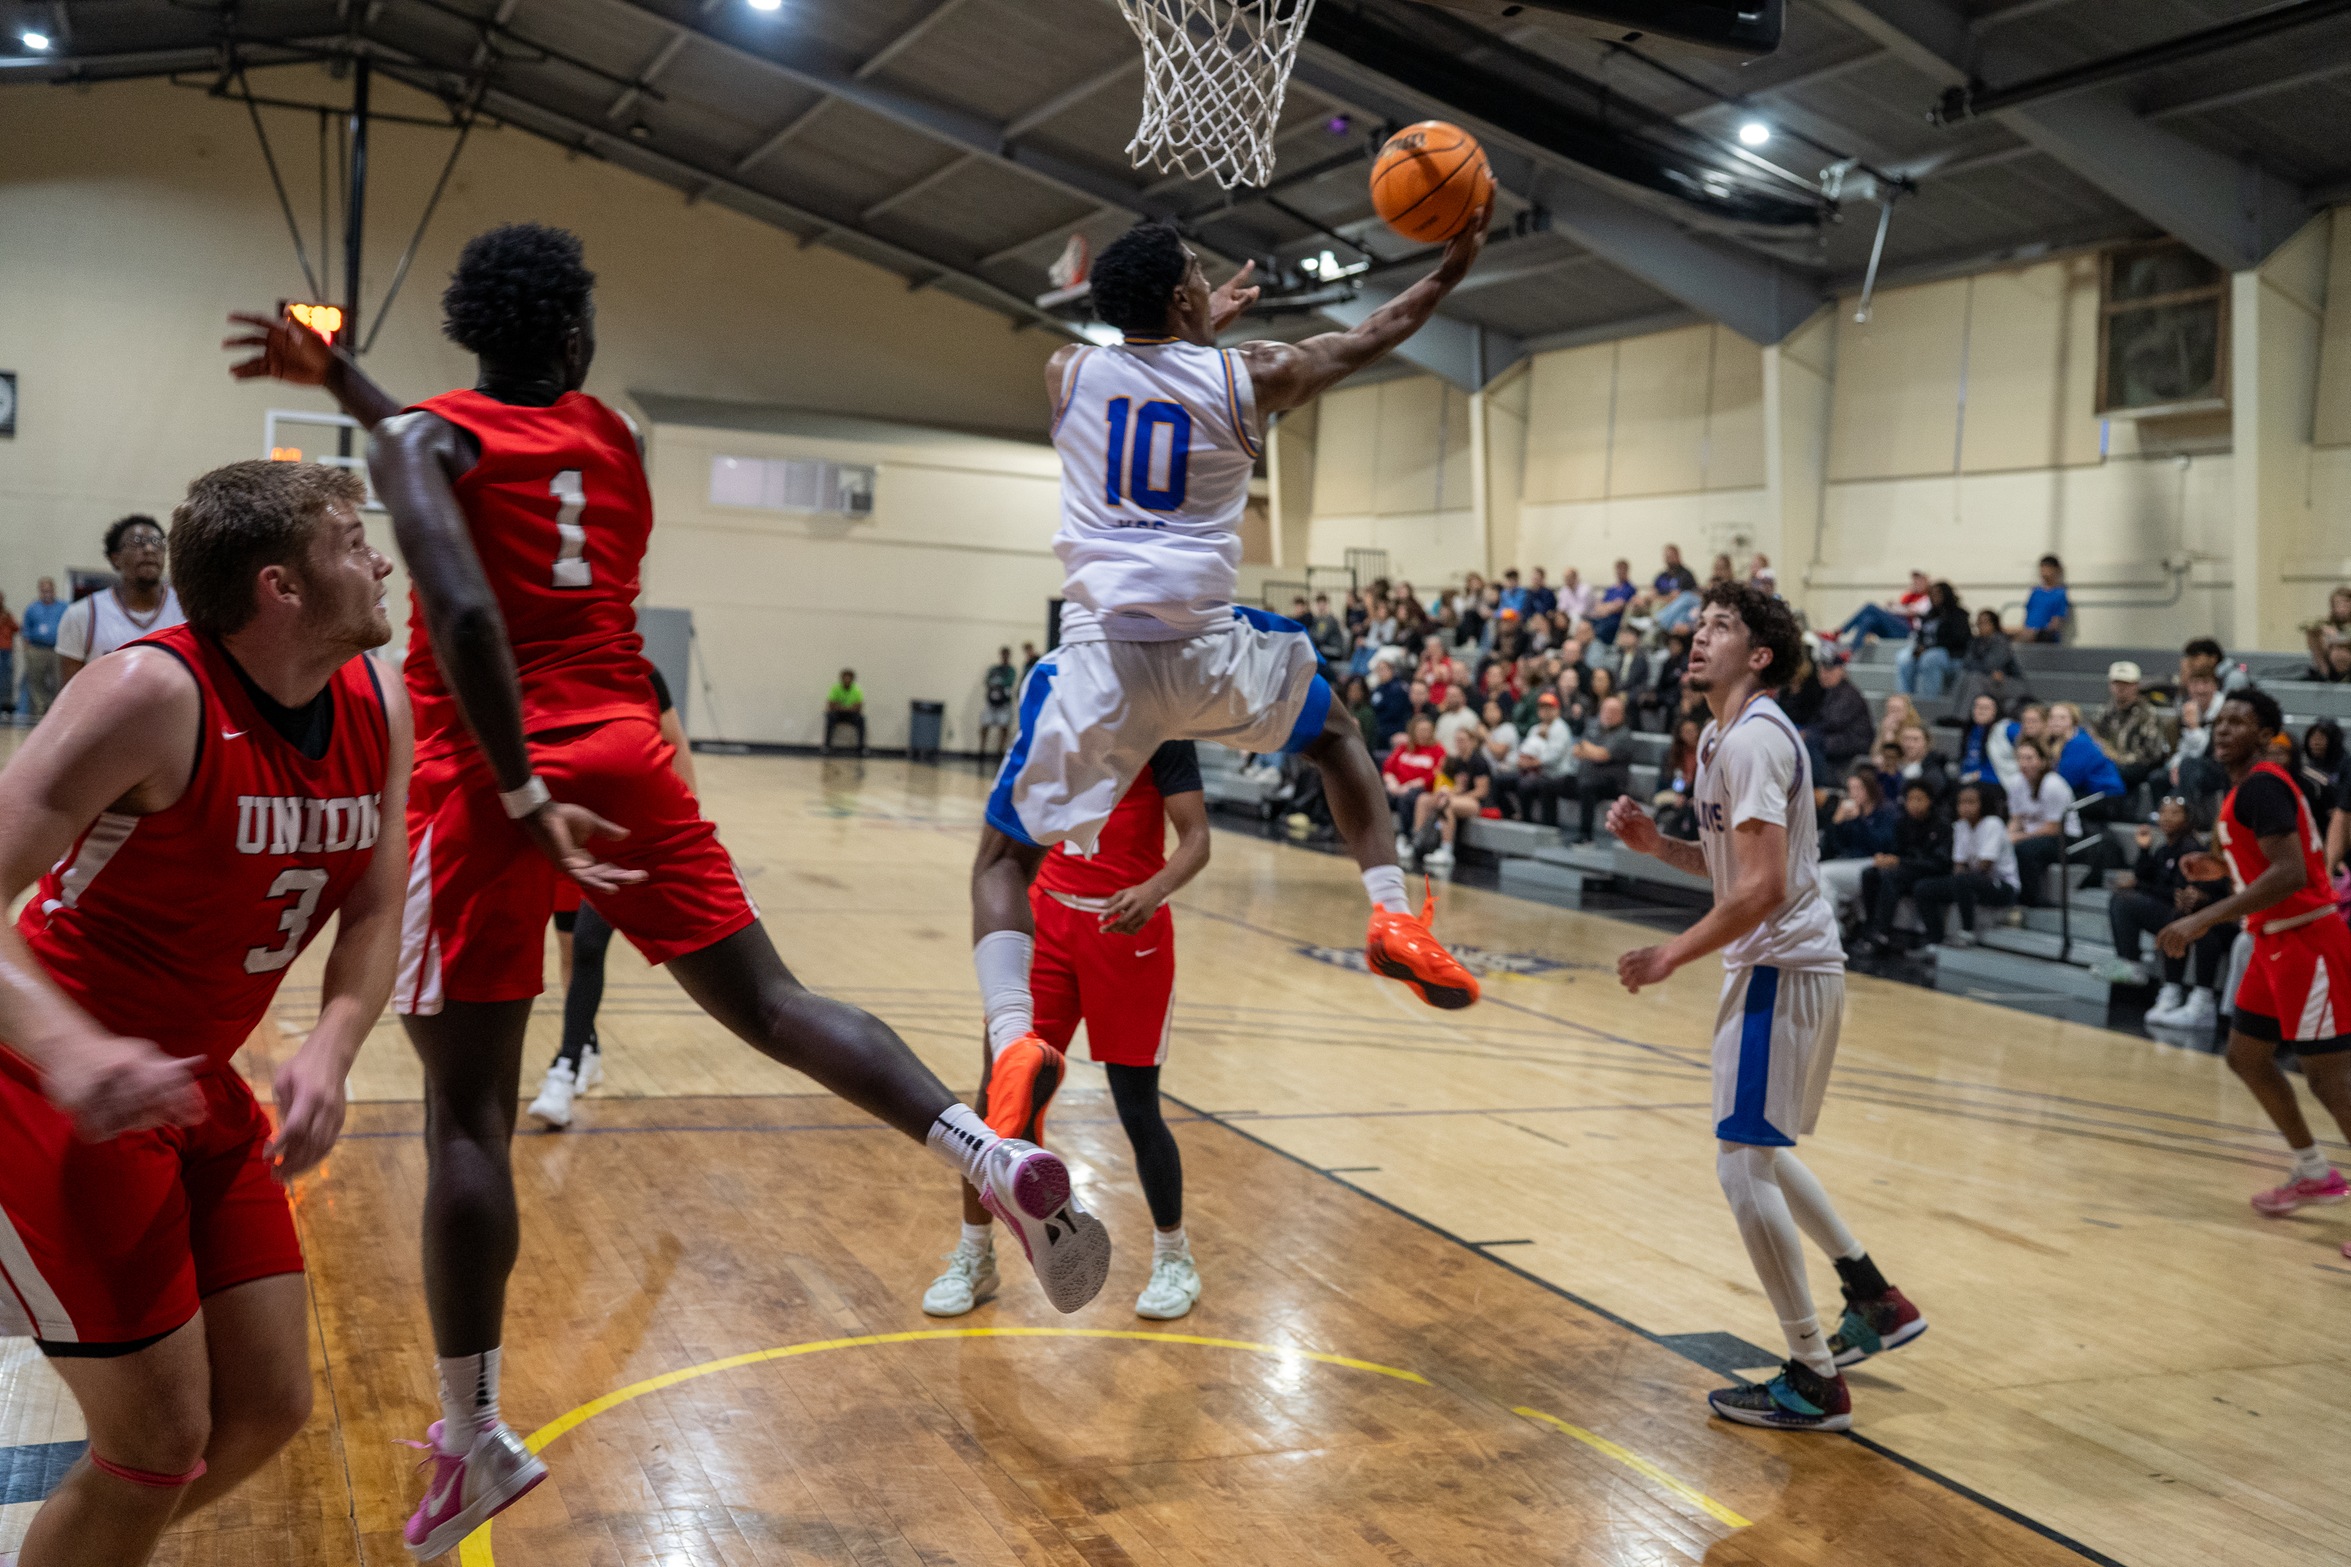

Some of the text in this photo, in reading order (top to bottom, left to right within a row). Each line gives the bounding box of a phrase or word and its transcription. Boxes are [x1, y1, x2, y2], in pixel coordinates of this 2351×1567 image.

[1105, 394, 1193, 514] 10
[549, 469, 593, 587] 1
[235, 791, 381, 855] UNION
[243, 867, 330, 975] 3
